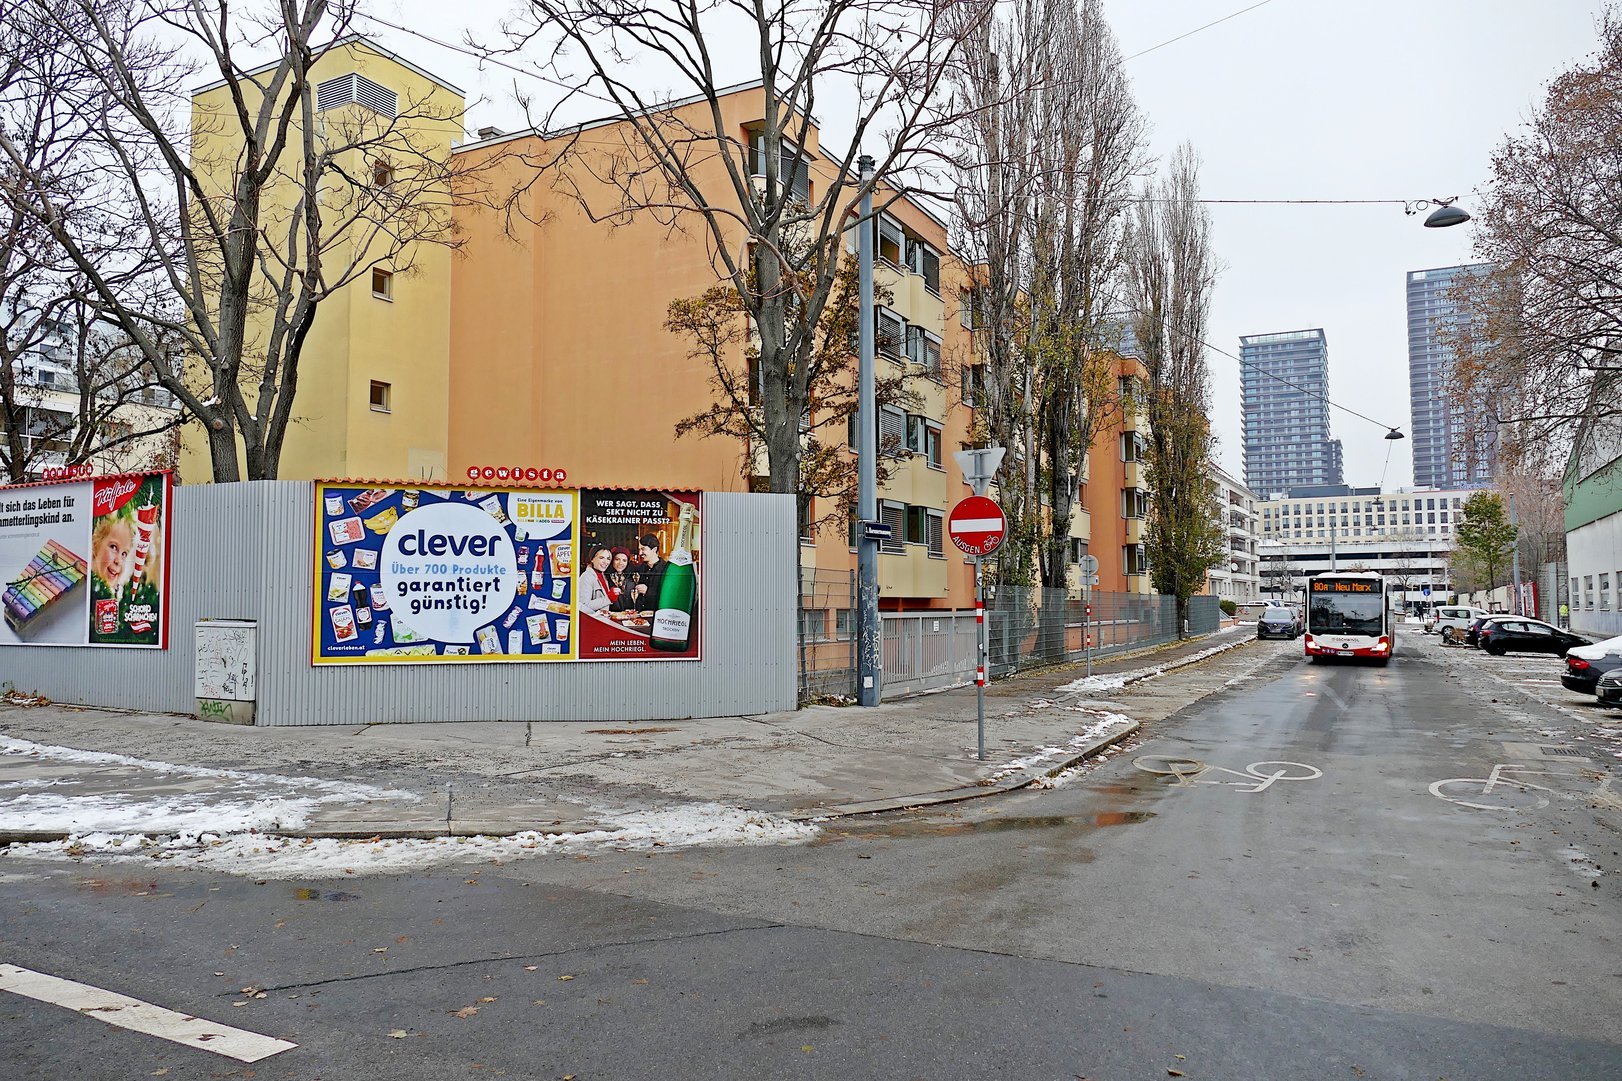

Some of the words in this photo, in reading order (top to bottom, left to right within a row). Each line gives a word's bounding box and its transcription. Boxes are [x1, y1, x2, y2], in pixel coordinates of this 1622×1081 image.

[469, 467, 565, 480] gewista
[6, 501, 20, 512] sich
[23, 500, 36, 511] das
[38, 498, 61, 510] Leben
[64, 496, 74, 507] für
[517, 503, 564, 518] BILLA
[62, 513, 74, 522] an.
[586, 515, 641, 524] KÄSEKRAINER
[398, 529, 502, 556] clever
[952, 536, 982, 554] AUSGEN.
[392, 562, 420, 574] Über
[425, 564, 448, 574] 700
[452, 564, 506, 574] Produkte
[398, 577, 500, 596] garantiert
[1314, 583, 1328, 591] 80A
[1336, 583, 1350, 591] Neu
[1352, 583, 1372, 591] Marx
[410, 594, 486, 614] günstig!
